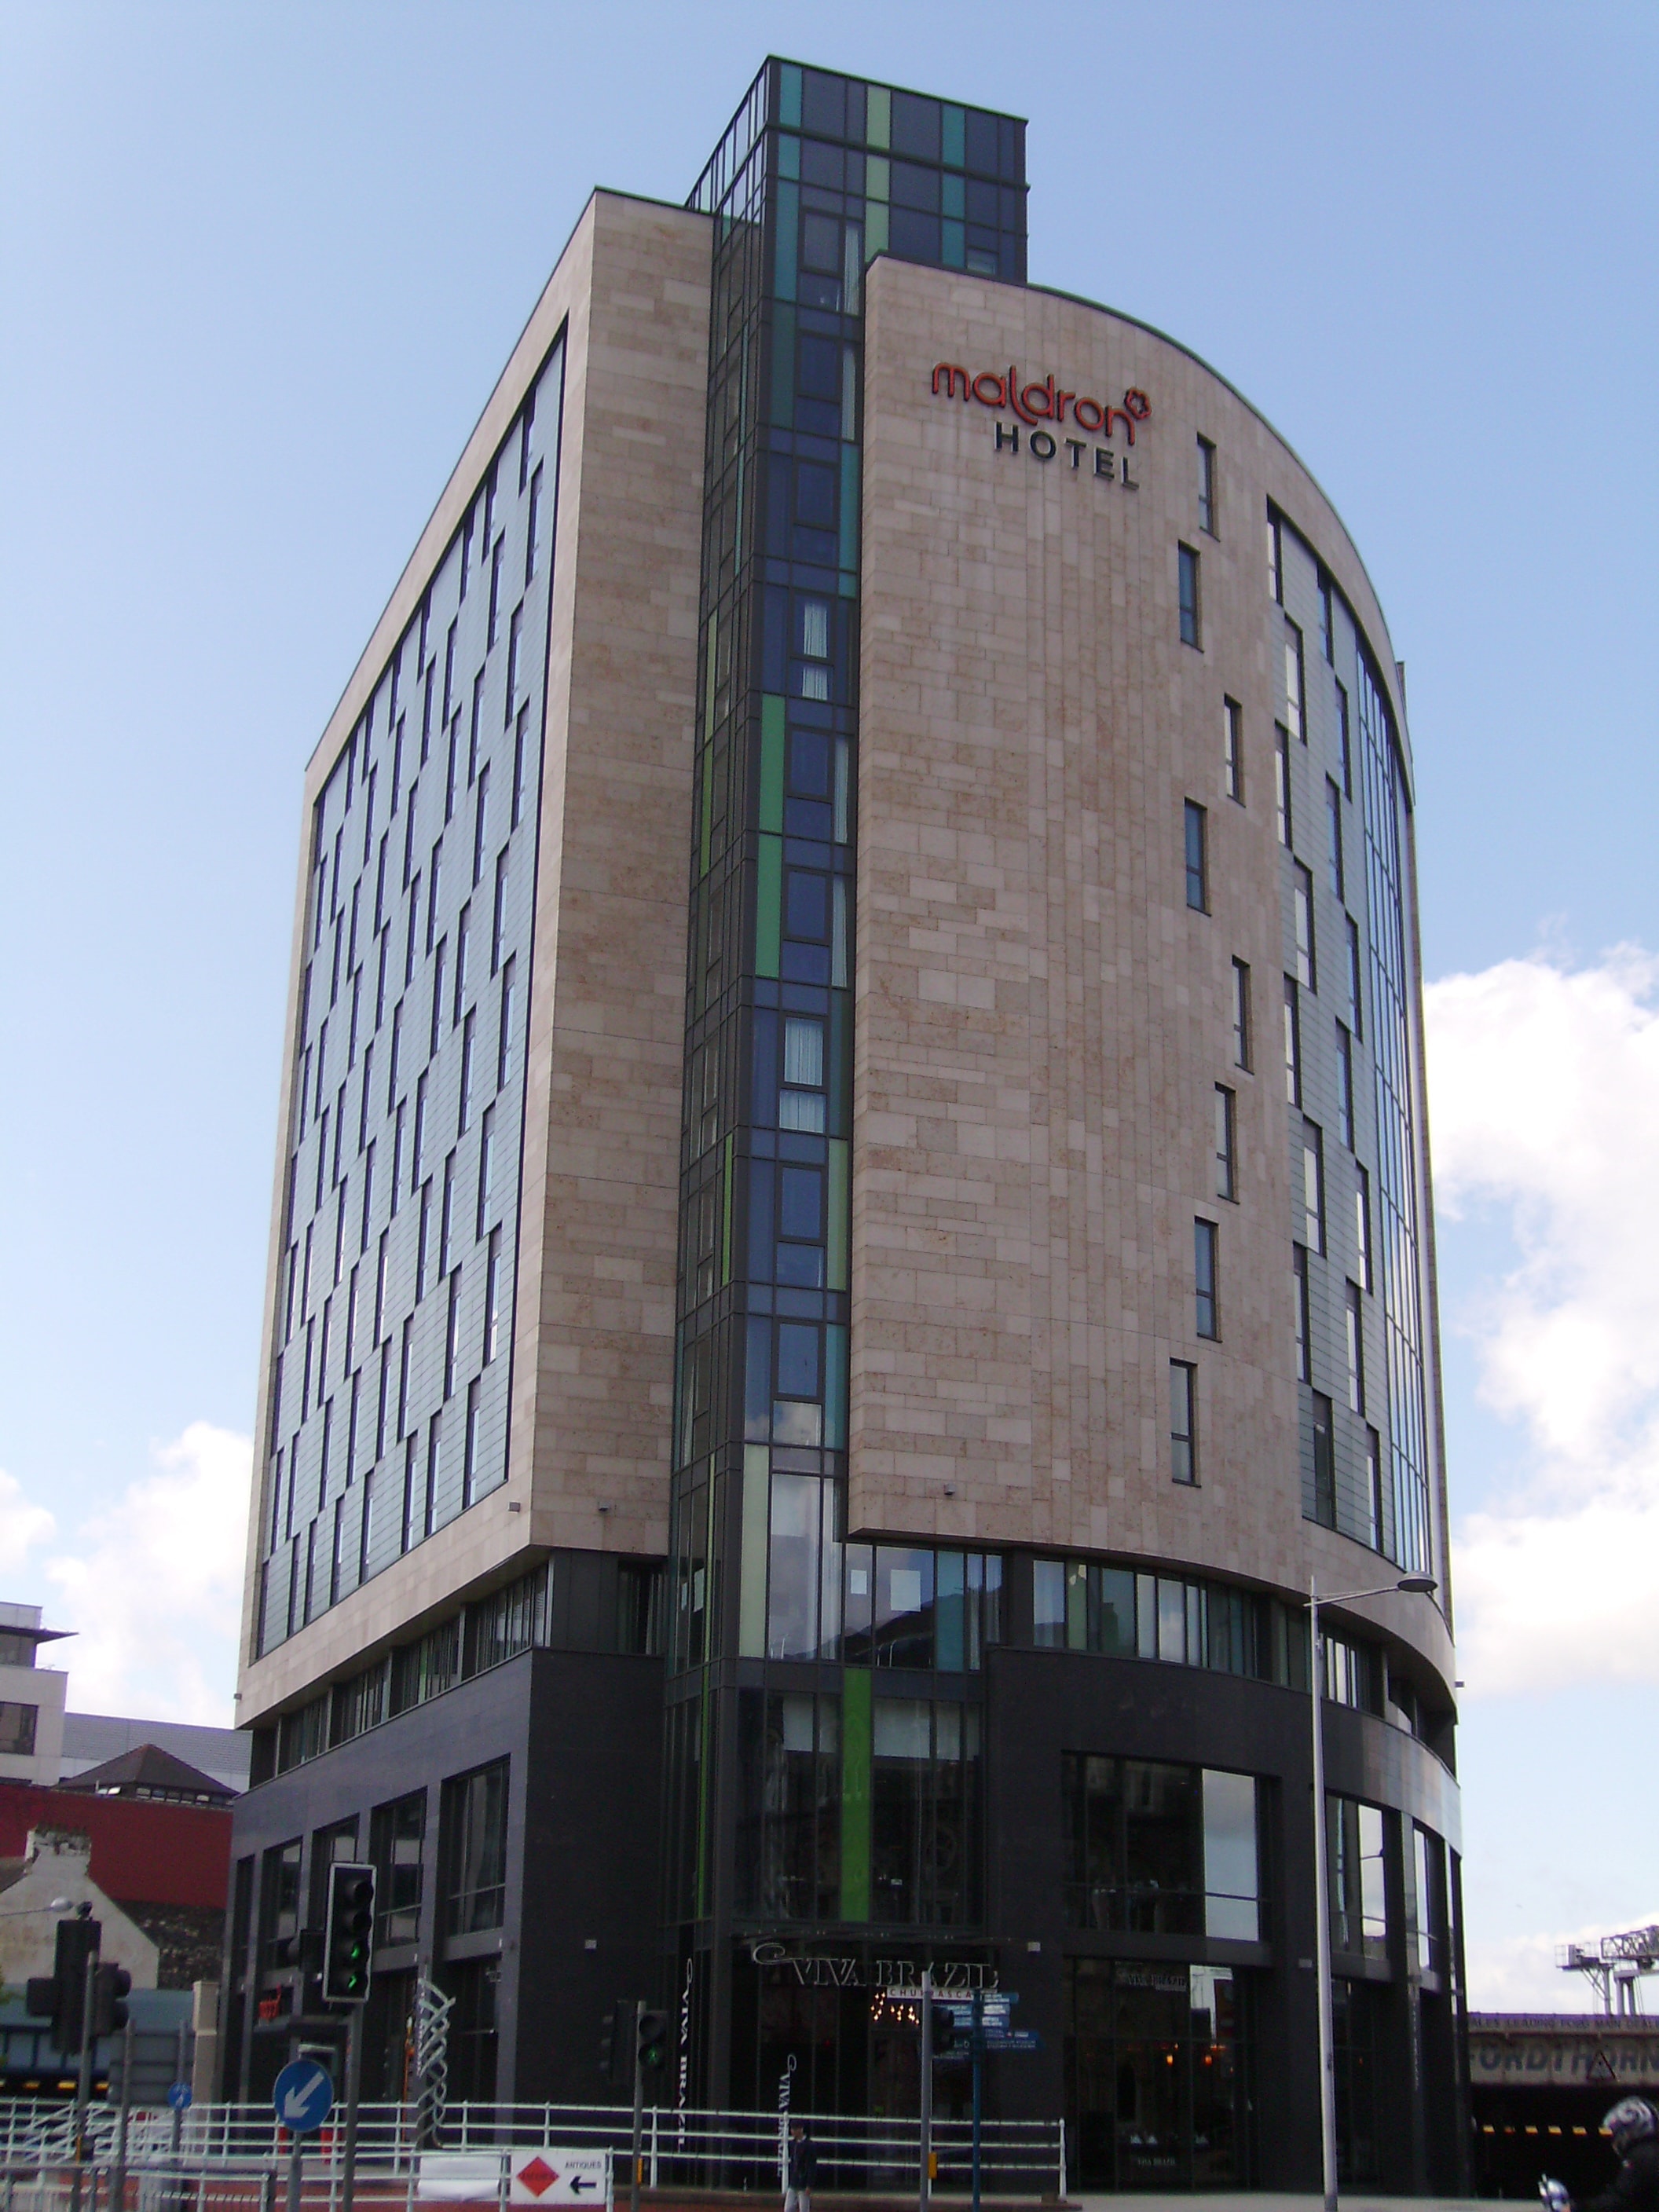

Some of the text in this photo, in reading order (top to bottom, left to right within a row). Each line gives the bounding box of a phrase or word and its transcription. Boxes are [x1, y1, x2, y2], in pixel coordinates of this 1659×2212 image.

[932, 361, 1135, 445] maldron
[994, 420, 1140, 490] HOTEL
[875, 1960, 998, 1990] BRAZIL
[565, 2161, 602, 2170] ANTIQUES
